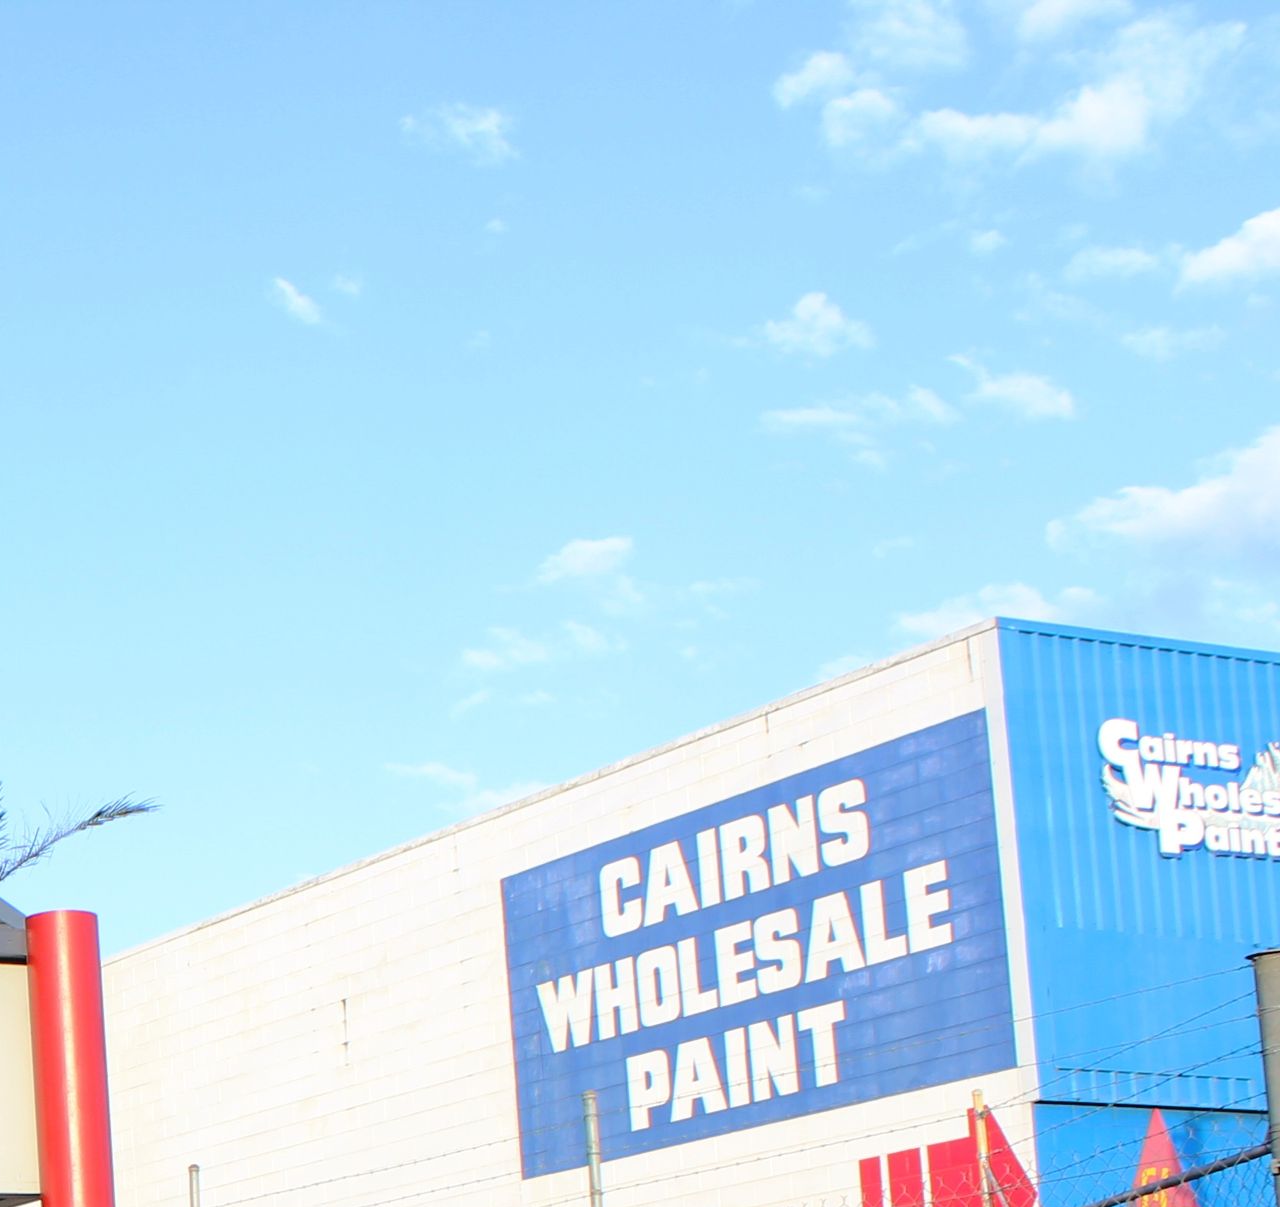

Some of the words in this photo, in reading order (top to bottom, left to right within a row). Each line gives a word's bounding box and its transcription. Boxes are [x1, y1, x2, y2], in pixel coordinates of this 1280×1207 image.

[1098, 718, 1241, 770] Cairns
[599, 778, 870, 939] CAIRNS
[536, 859, 953, 1055] WHOLESALE
[625, 1000, 846, 1132] PAINT
